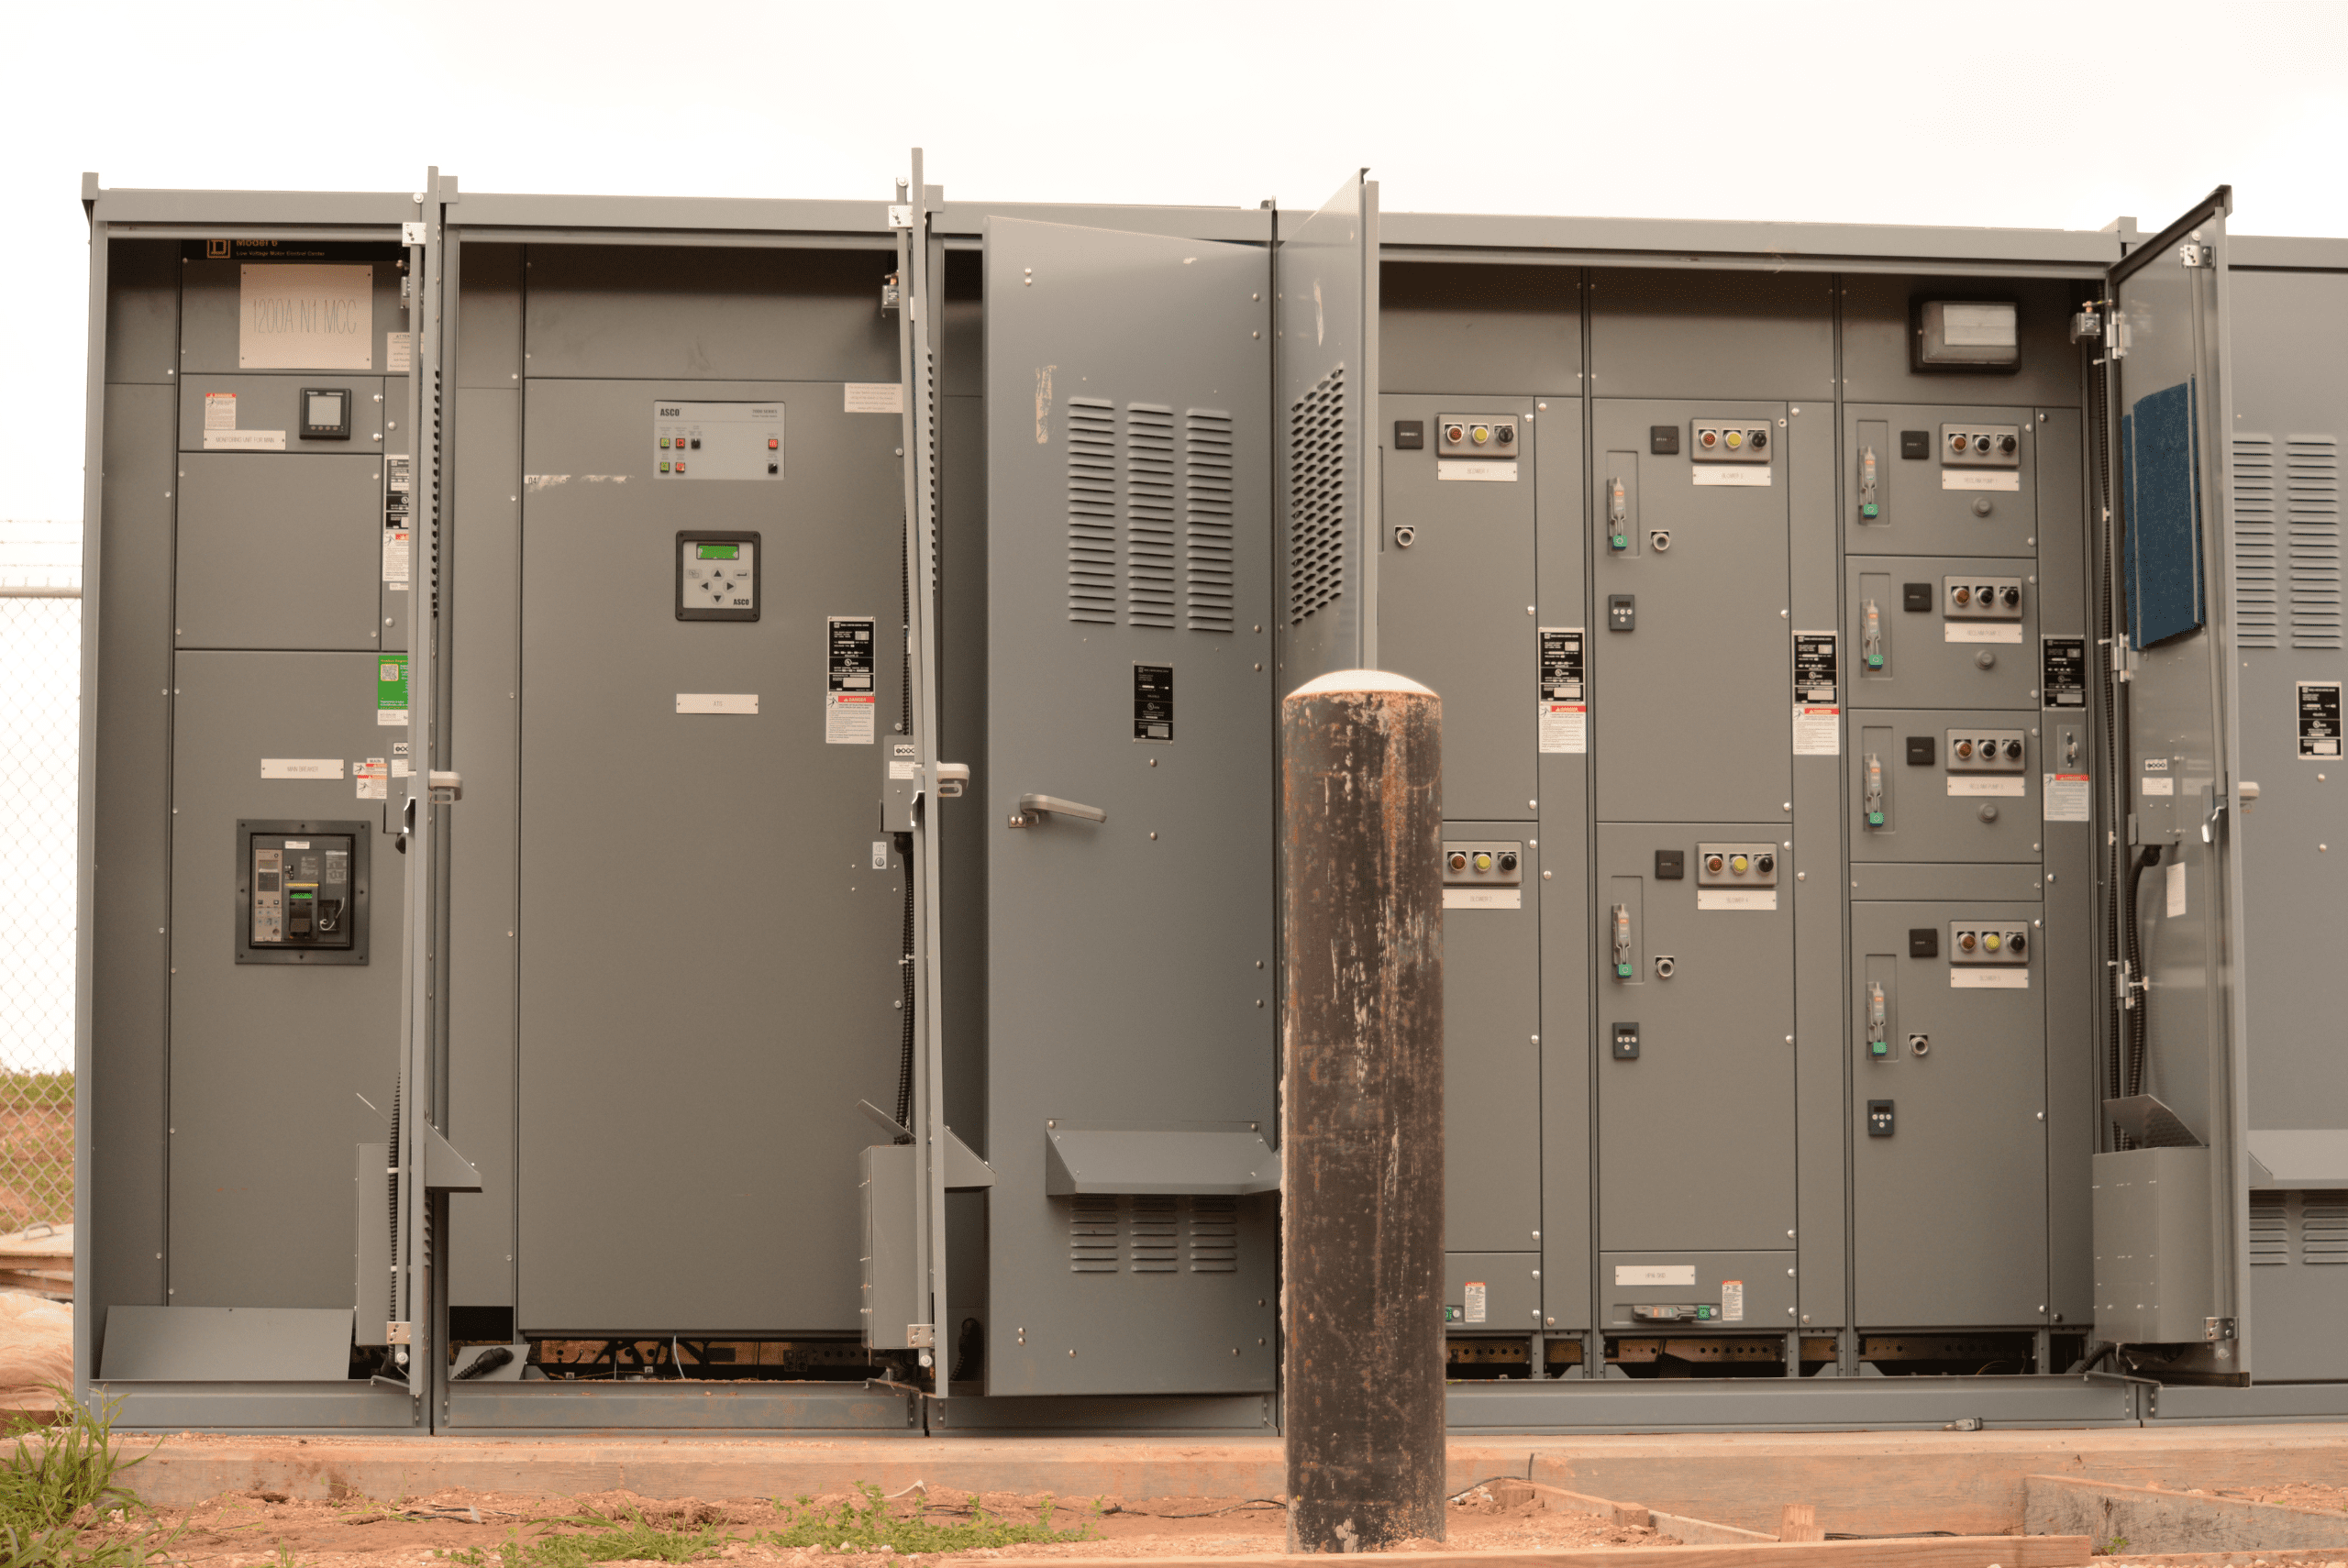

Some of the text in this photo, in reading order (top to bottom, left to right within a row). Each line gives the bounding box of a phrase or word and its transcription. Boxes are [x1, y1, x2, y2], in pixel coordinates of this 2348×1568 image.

[253, 298, 357, 335] 1200A N1 MCC
[660, 408, 680, 416] ASCO
